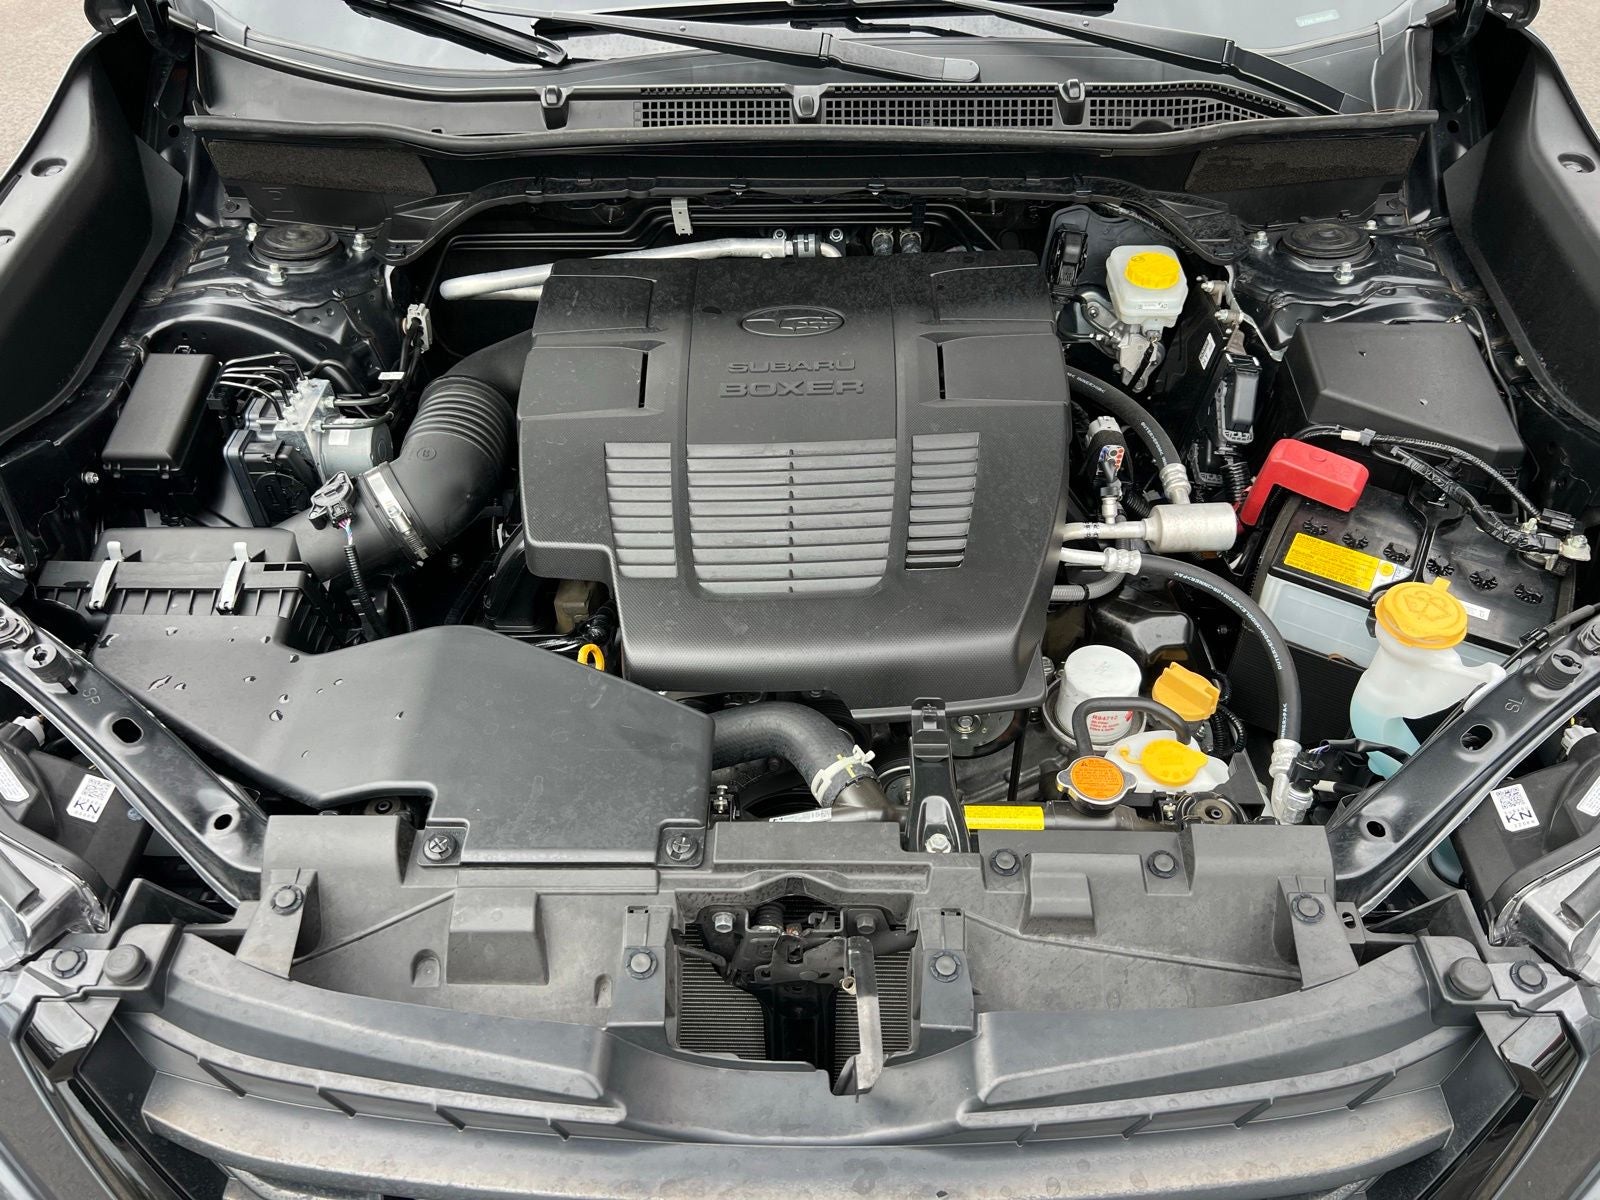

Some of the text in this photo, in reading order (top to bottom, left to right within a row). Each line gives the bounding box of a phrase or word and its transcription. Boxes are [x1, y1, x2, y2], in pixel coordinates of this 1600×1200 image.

[728, 360, 856, 374] SUBARU
[720, 380, 865, 398] BOXER
[1504, 696, 1525, 713] SL
[73, 799, 101, 814] KN
[1505, 809, 1533, 823] KN
